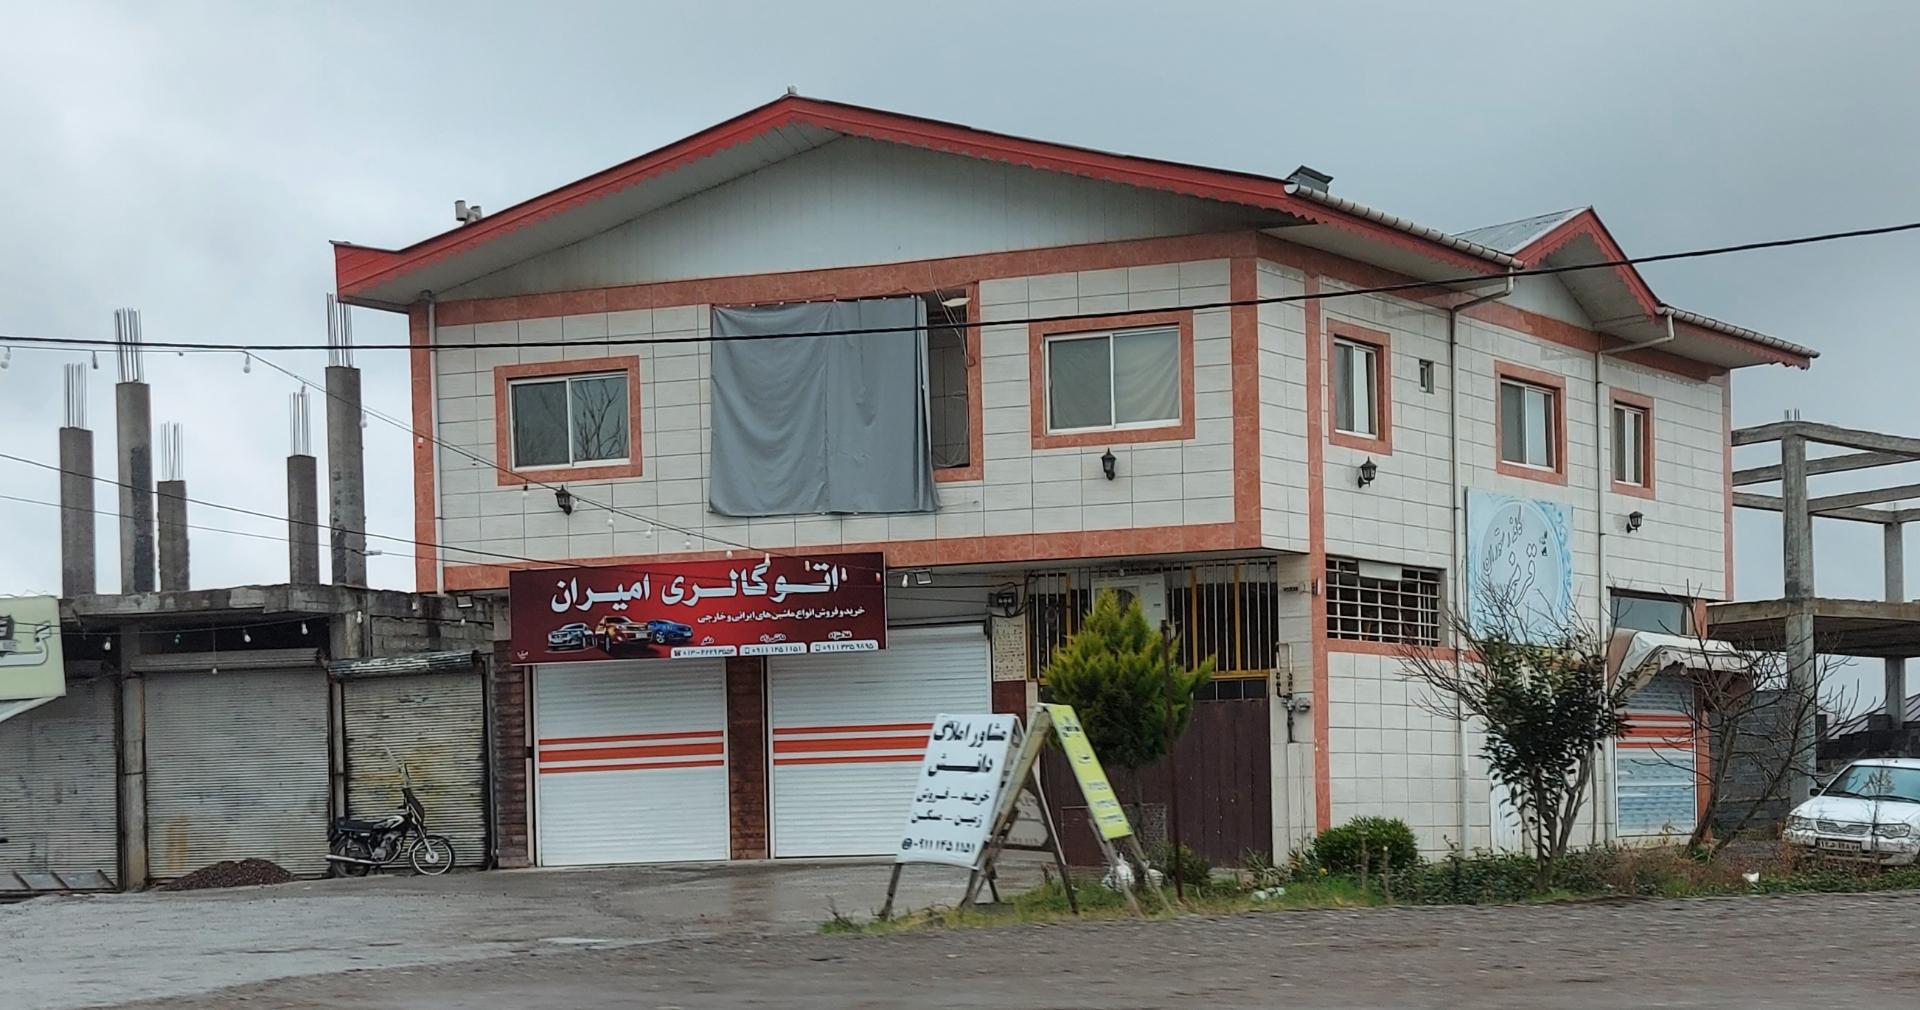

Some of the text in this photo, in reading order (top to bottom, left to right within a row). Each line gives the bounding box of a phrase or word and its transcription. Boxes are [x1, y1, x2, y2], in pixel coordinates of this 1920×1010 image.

[551, 573, 650, 613] امیران
[697, 613, 727, 624] خارجی
[732, 611, 755, 622] ایرانی
[797, 608, 815, 620] انواع
[815, 606, 839, 618] فروش
[844, 606, 866, 617] خرید
[928, 752, 994, 777] دانش
[916, 786, 950, 803] فروش
[961, 789, 990, 806] خرید
[910, 809, 943, 824] مسکن
[954, 813, 983, 828] زمین
